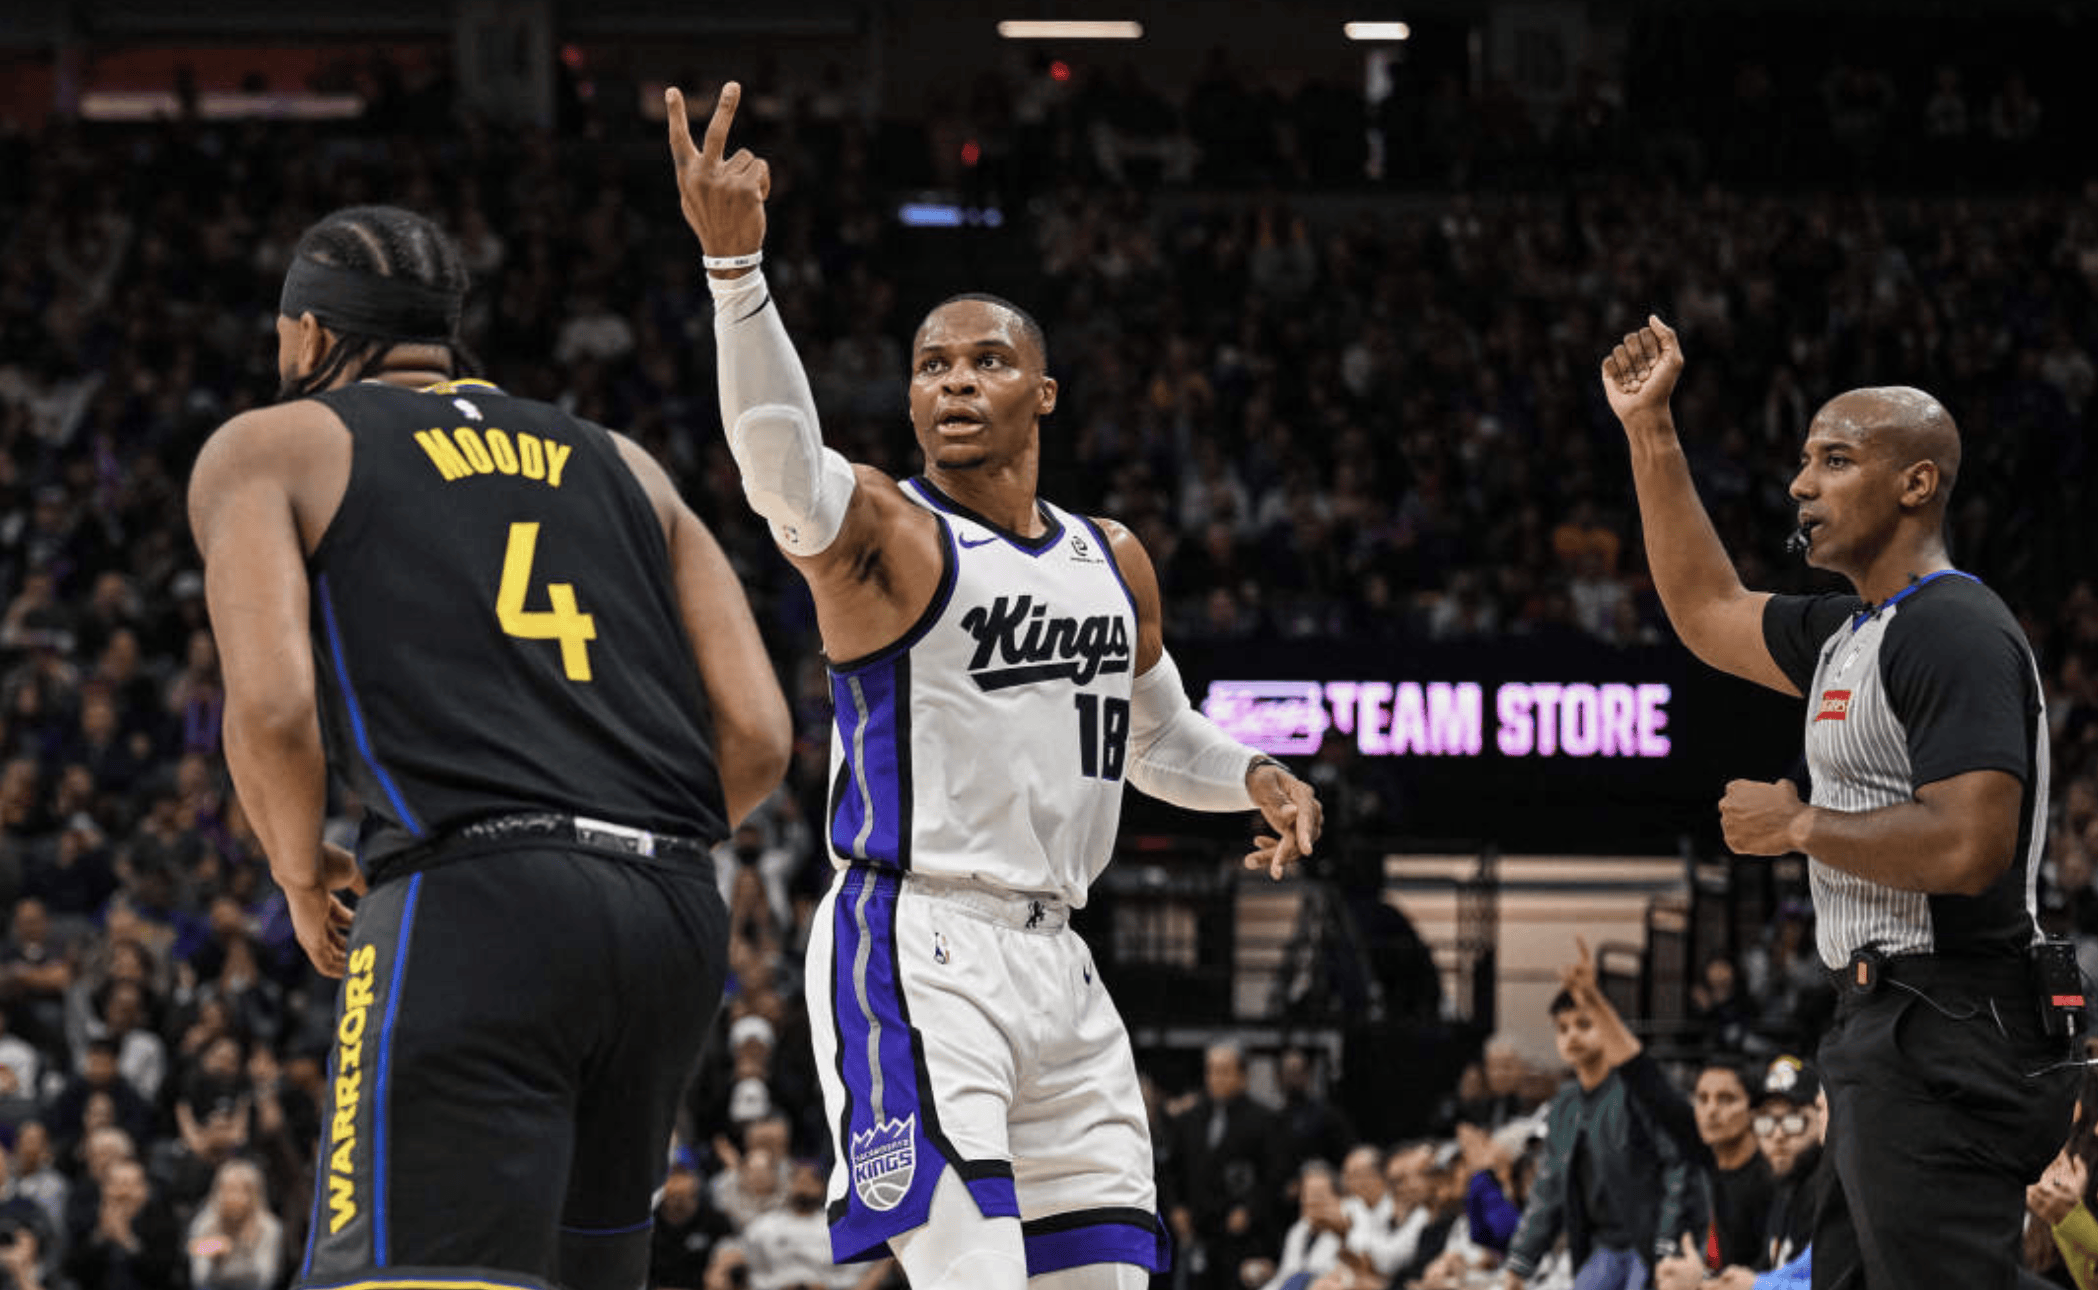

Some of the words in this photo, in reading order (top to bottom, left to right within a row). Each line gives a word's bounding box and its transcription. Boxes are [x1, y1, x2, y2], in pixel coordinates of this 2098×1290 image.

[413, 426, 571, 487] MOODY
[496, 522, 597, 681] 4
[961, 595, 1129, 686] Kings
[1075, 693, 1129, 781] 18
[1327, 682, 1482, 755] TEAM
[1497, 682, 1670, 756] STORE
[329, 944, 376, 1234] WARRIORS
[855, 1150, 913, 1184] KINGS
